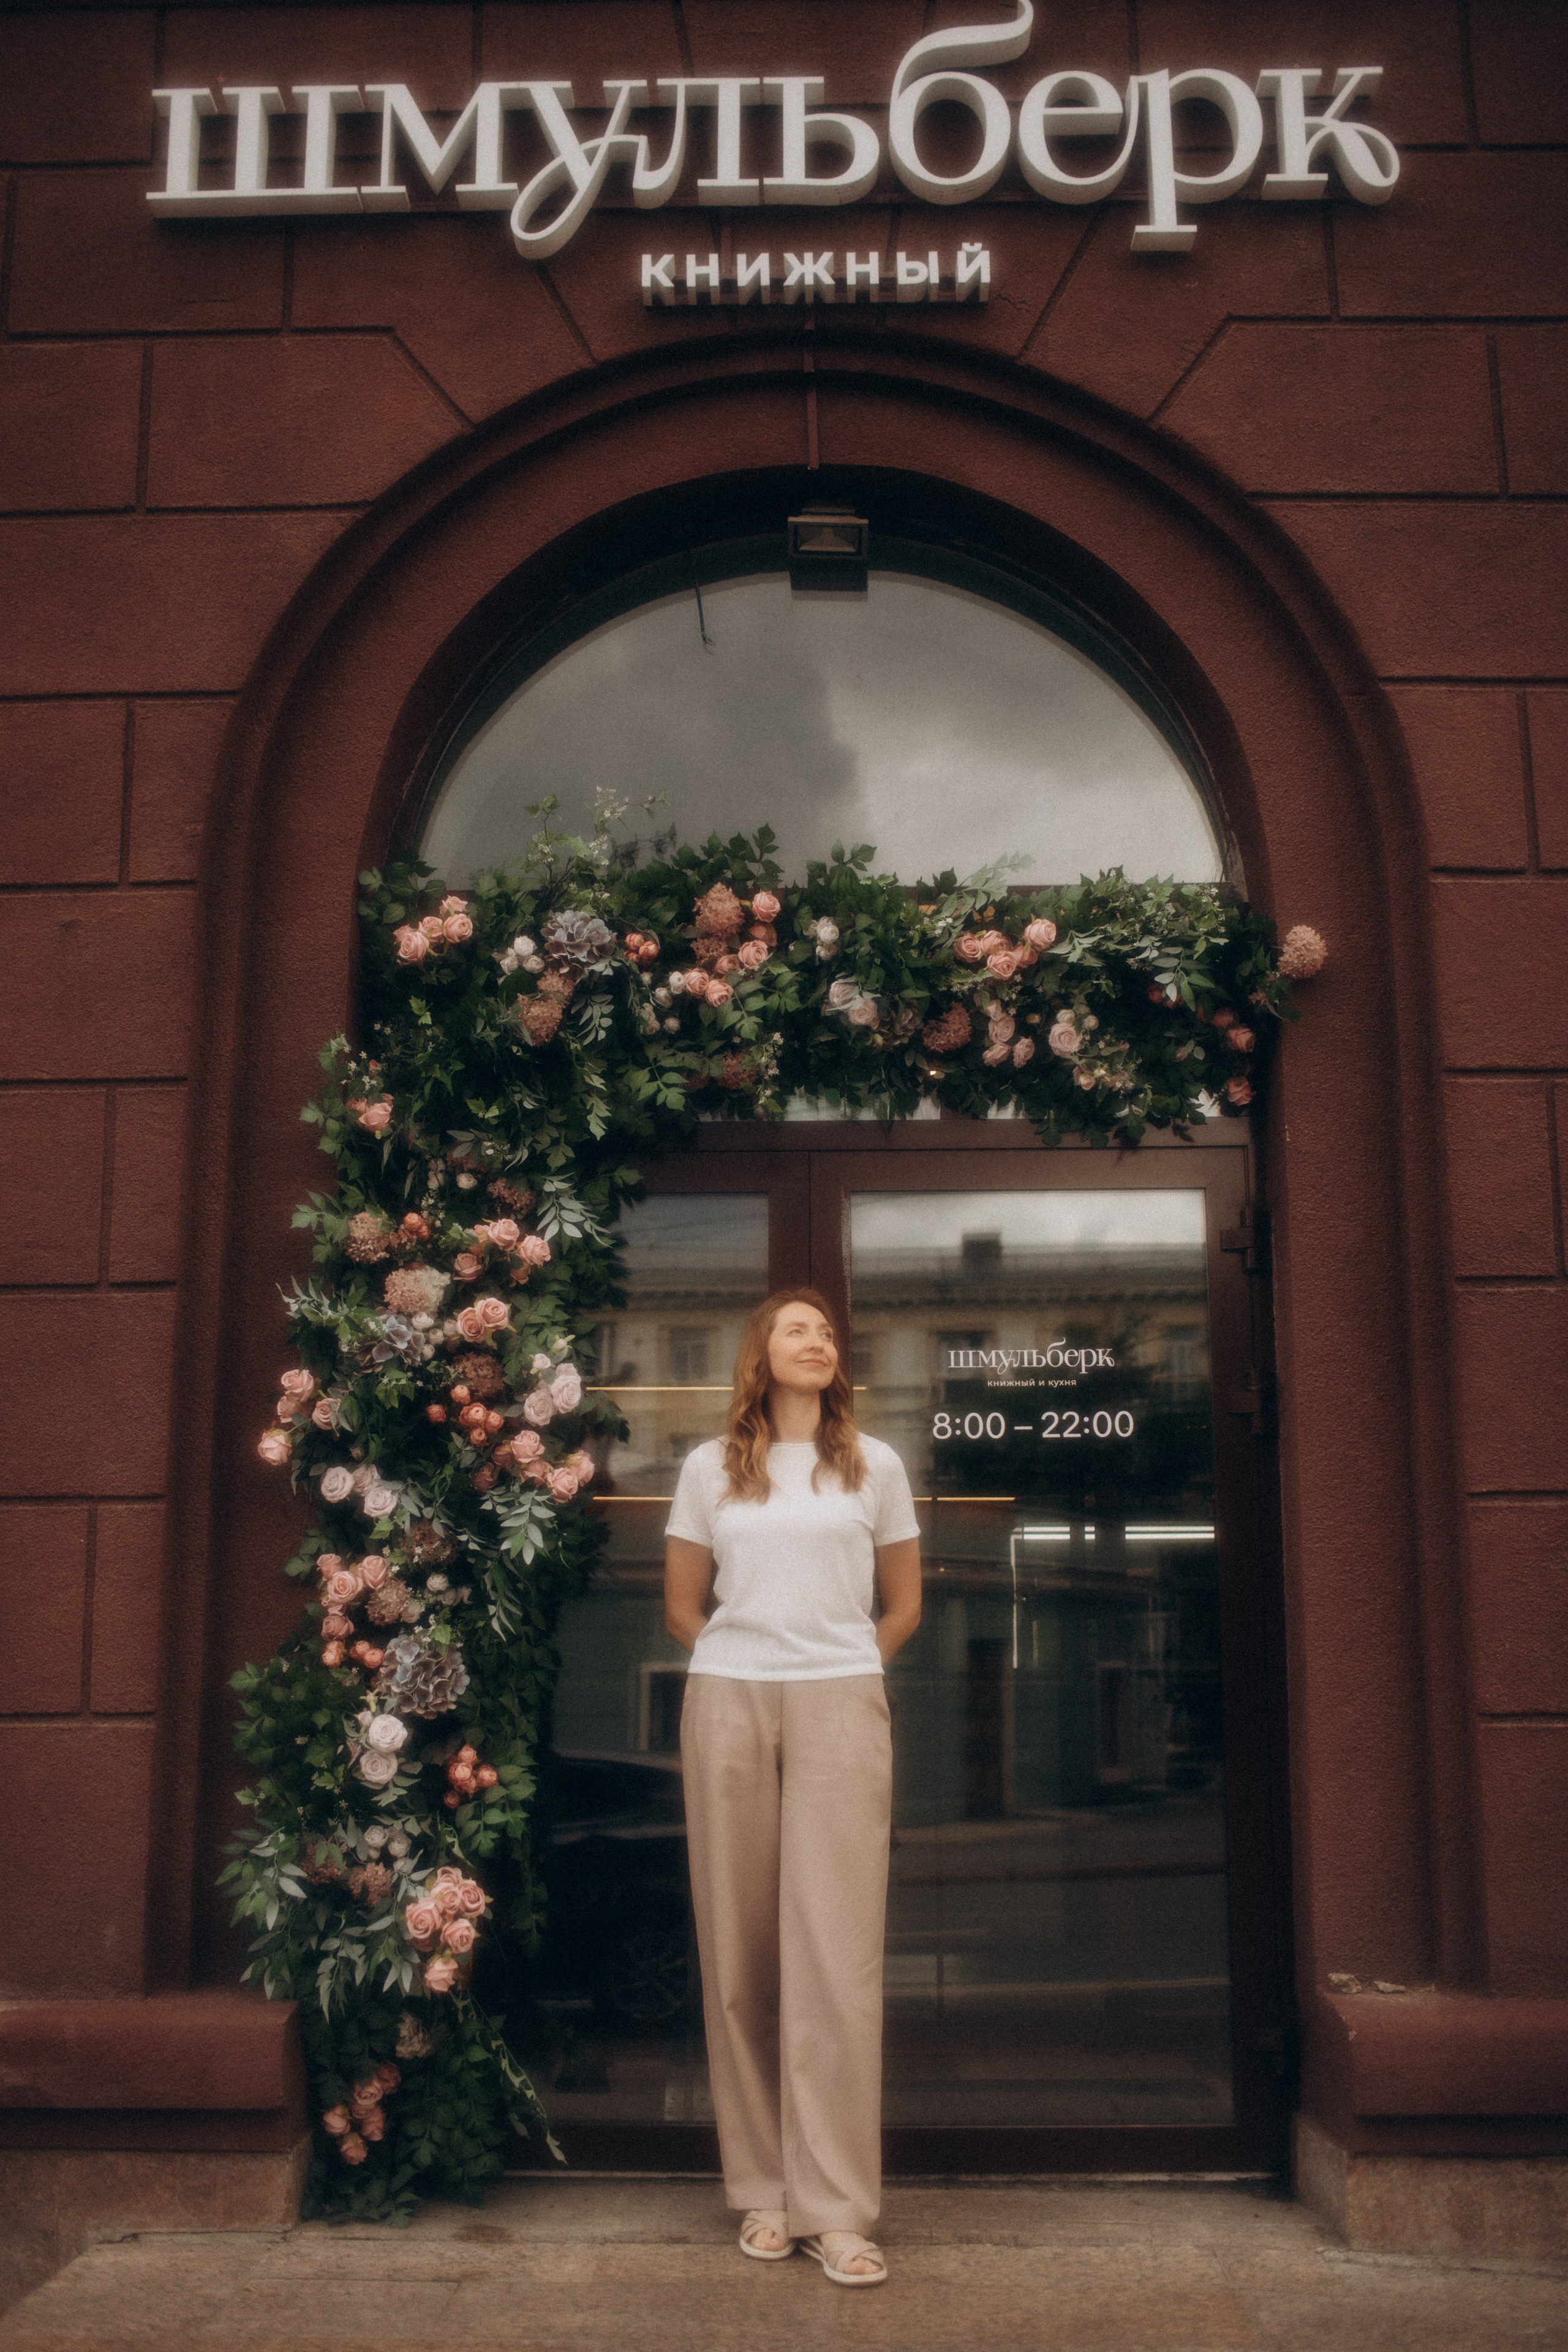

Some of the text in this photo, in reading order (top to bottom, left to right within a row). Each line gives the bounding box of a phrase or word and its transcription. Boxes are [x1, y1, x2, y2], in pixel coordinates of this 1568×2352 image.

[146, 0, 1401, 257] шмульберк
[948, 1337, 1115, 1375] шмульберк
[987, 1378, 1035, 1387] книжный
[1048, 1379, 1077, 1388] кухня
[932, 1412, 1006, 1439] 8:00
[1041, 1411, 1134, 1438] 22:00
